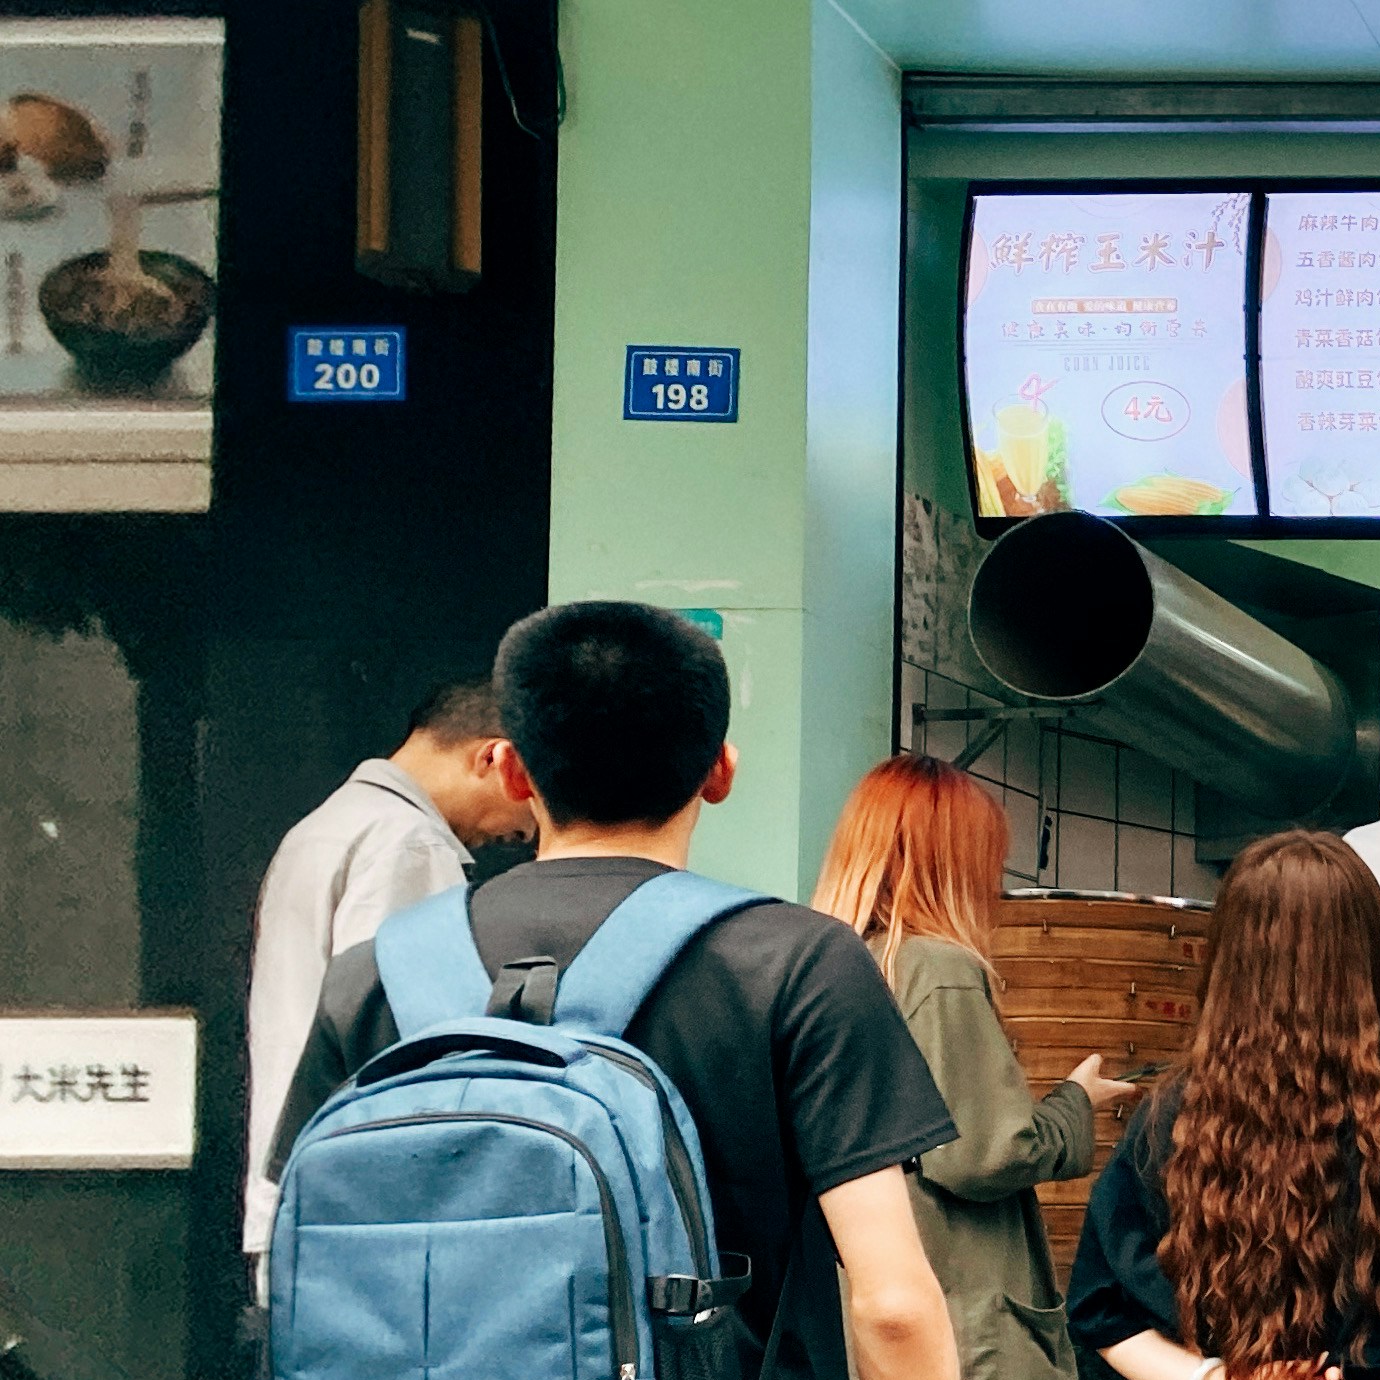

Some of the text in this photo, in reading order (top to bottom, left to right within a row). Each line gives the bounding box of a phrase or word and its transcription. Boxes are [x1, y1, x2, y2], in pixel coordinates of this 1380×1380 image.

[313, 362, 380, 390] 200
[651, 383, 709, 411] 198
[1123, 396, 1174, 423] 4元
[11, 1063, 151, 1103] 大米先生
